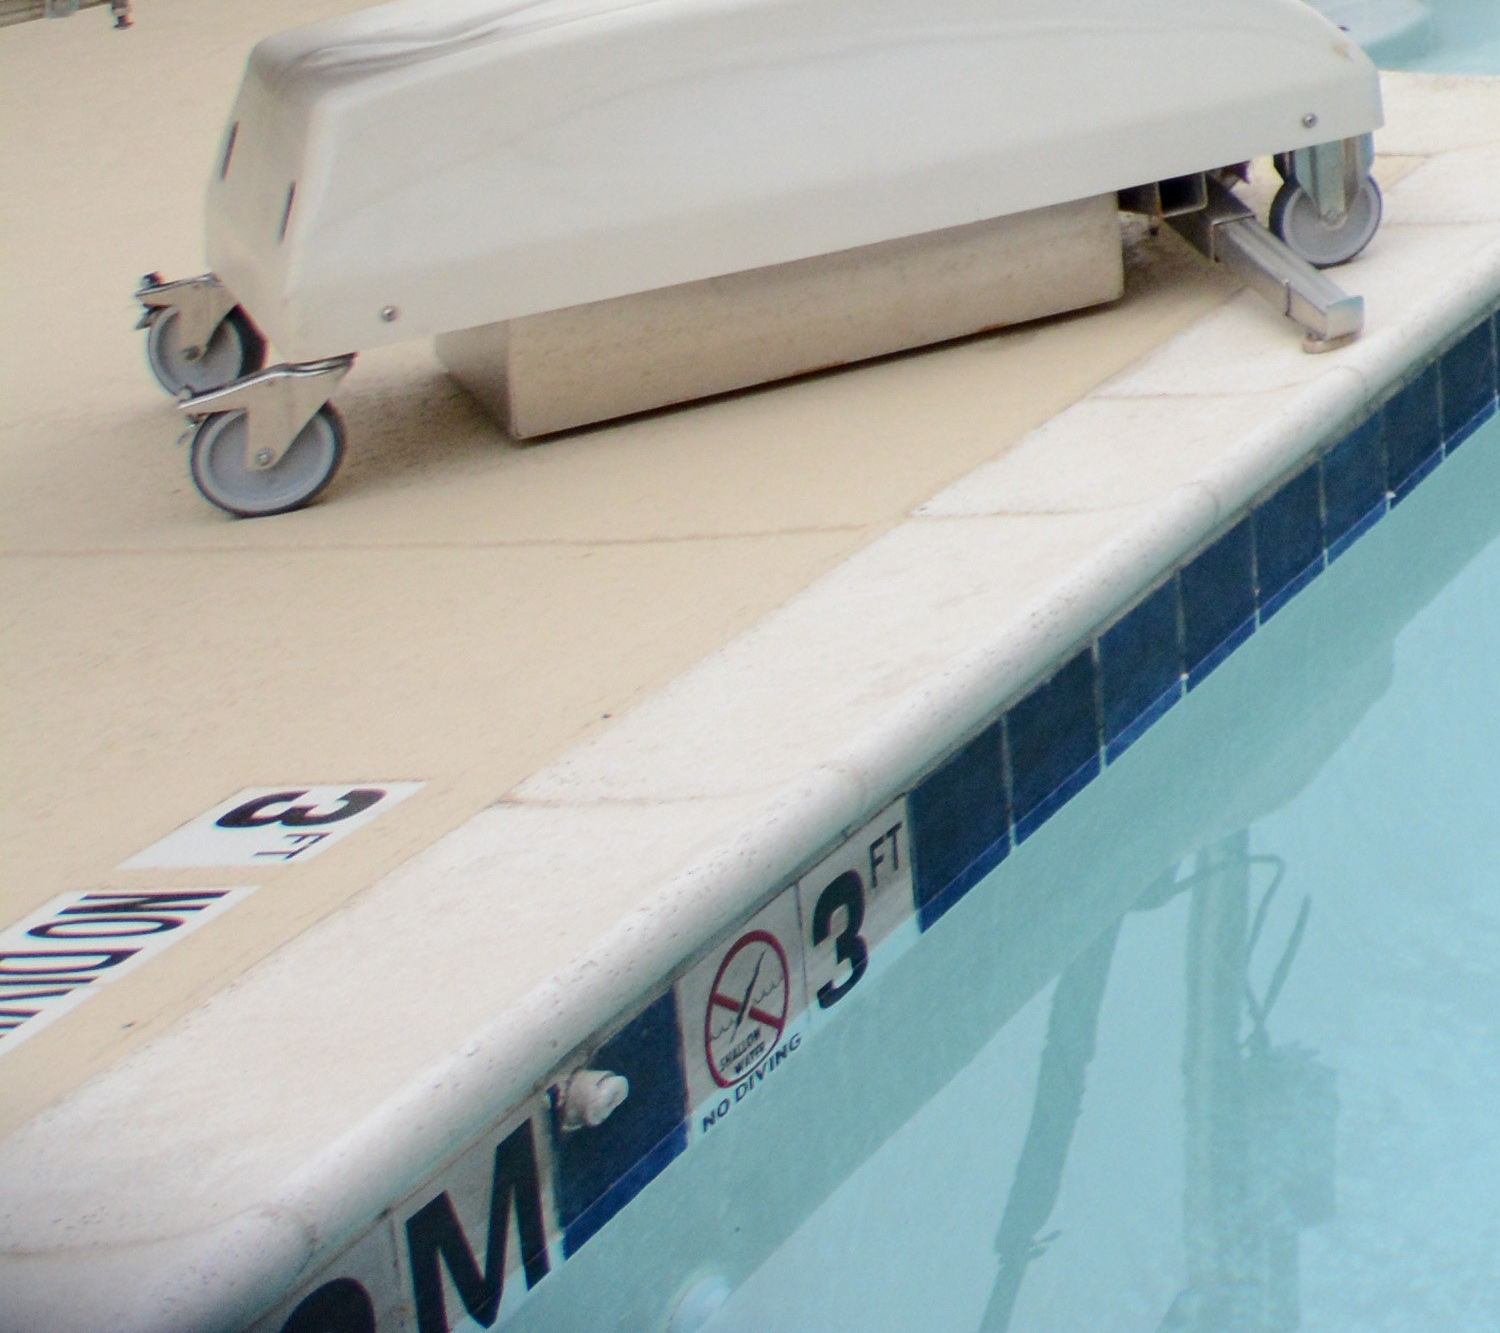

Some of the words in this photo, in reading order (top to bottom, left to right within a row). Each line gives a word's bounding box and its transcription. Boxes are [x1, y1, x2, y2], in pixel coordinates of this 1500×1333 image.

[214, 787, 388, 829] 3
[252, 831, 333, 860] FT
[23, 888, 233, 940] NO
[811, 867, 870, 1010] 3
[868, 821, 904, 890] FT
[702, 1097, 730, 1134] NO
[734, 1031, 802, 1105] DIVING
